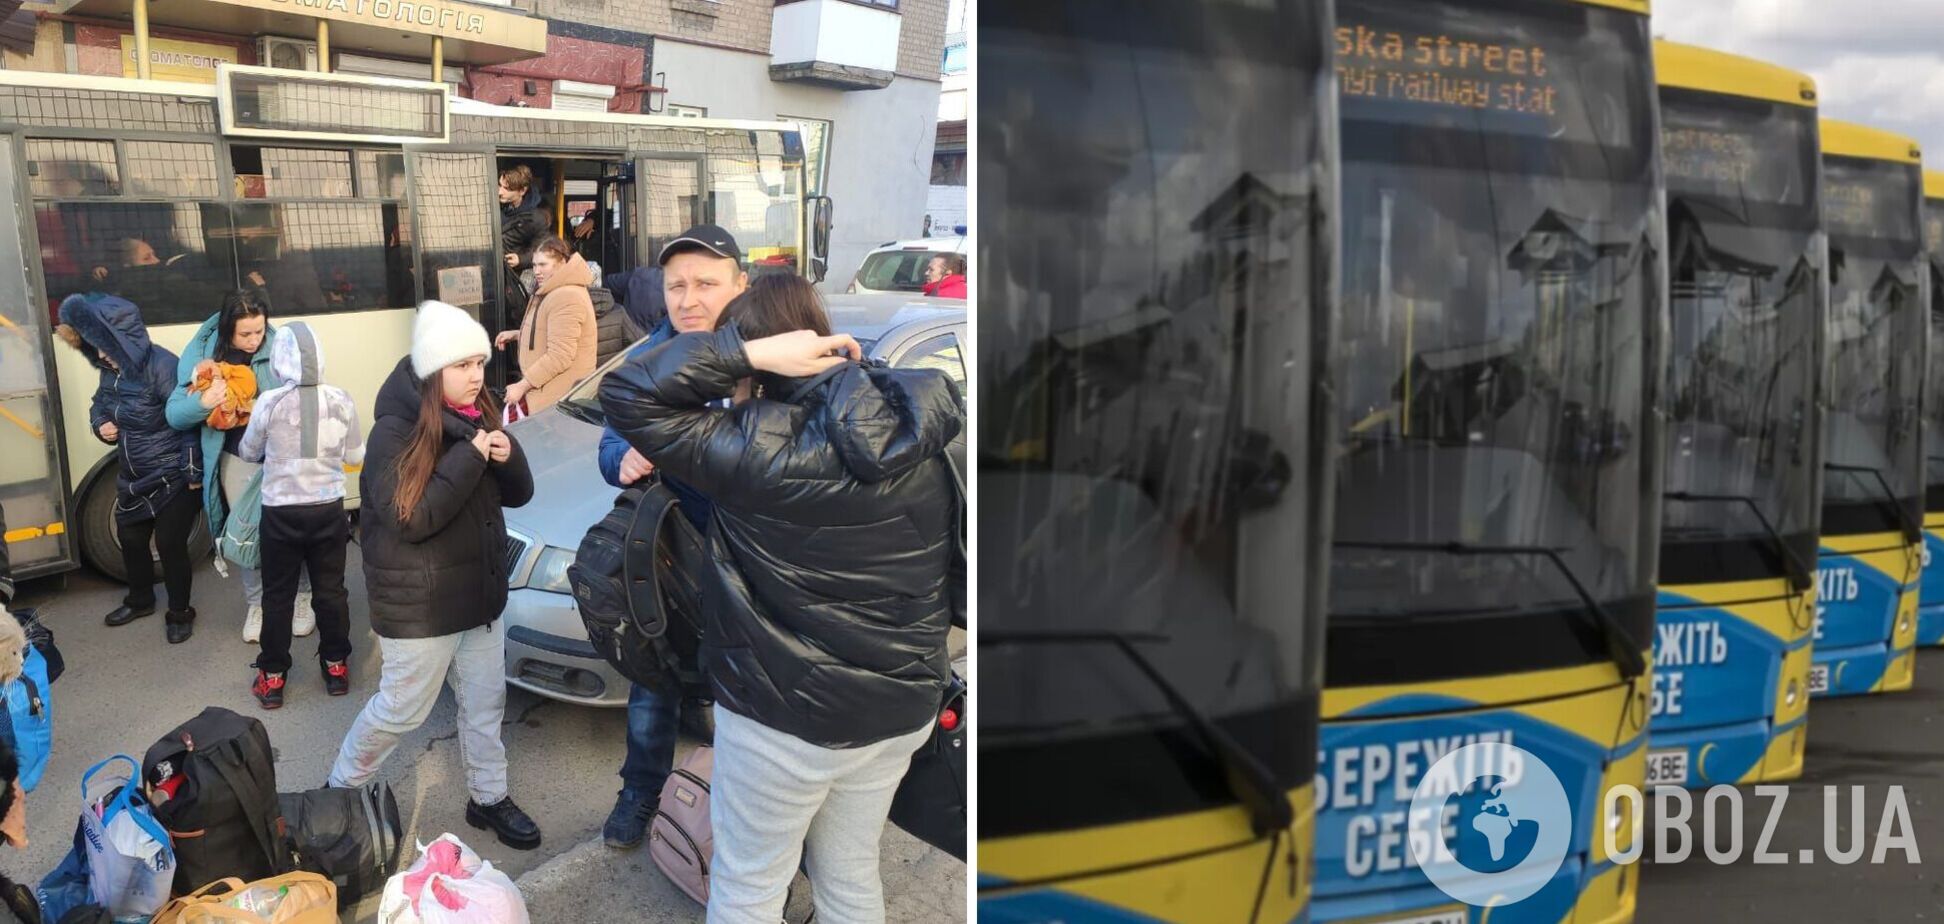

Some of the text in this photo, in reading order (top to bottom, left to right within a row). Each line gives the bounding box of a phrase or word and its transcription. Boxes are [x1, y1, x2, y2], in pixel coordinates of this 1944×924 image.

[1334, 26, 1546, 77] ska street
[1386, 72, 1490, 107] railway
[1498, 82, 1558, 115] stat
[1652, 621, 1727, 667] ЖІТЬ
[1345, 803, 1460, 878] СЕБЕ
